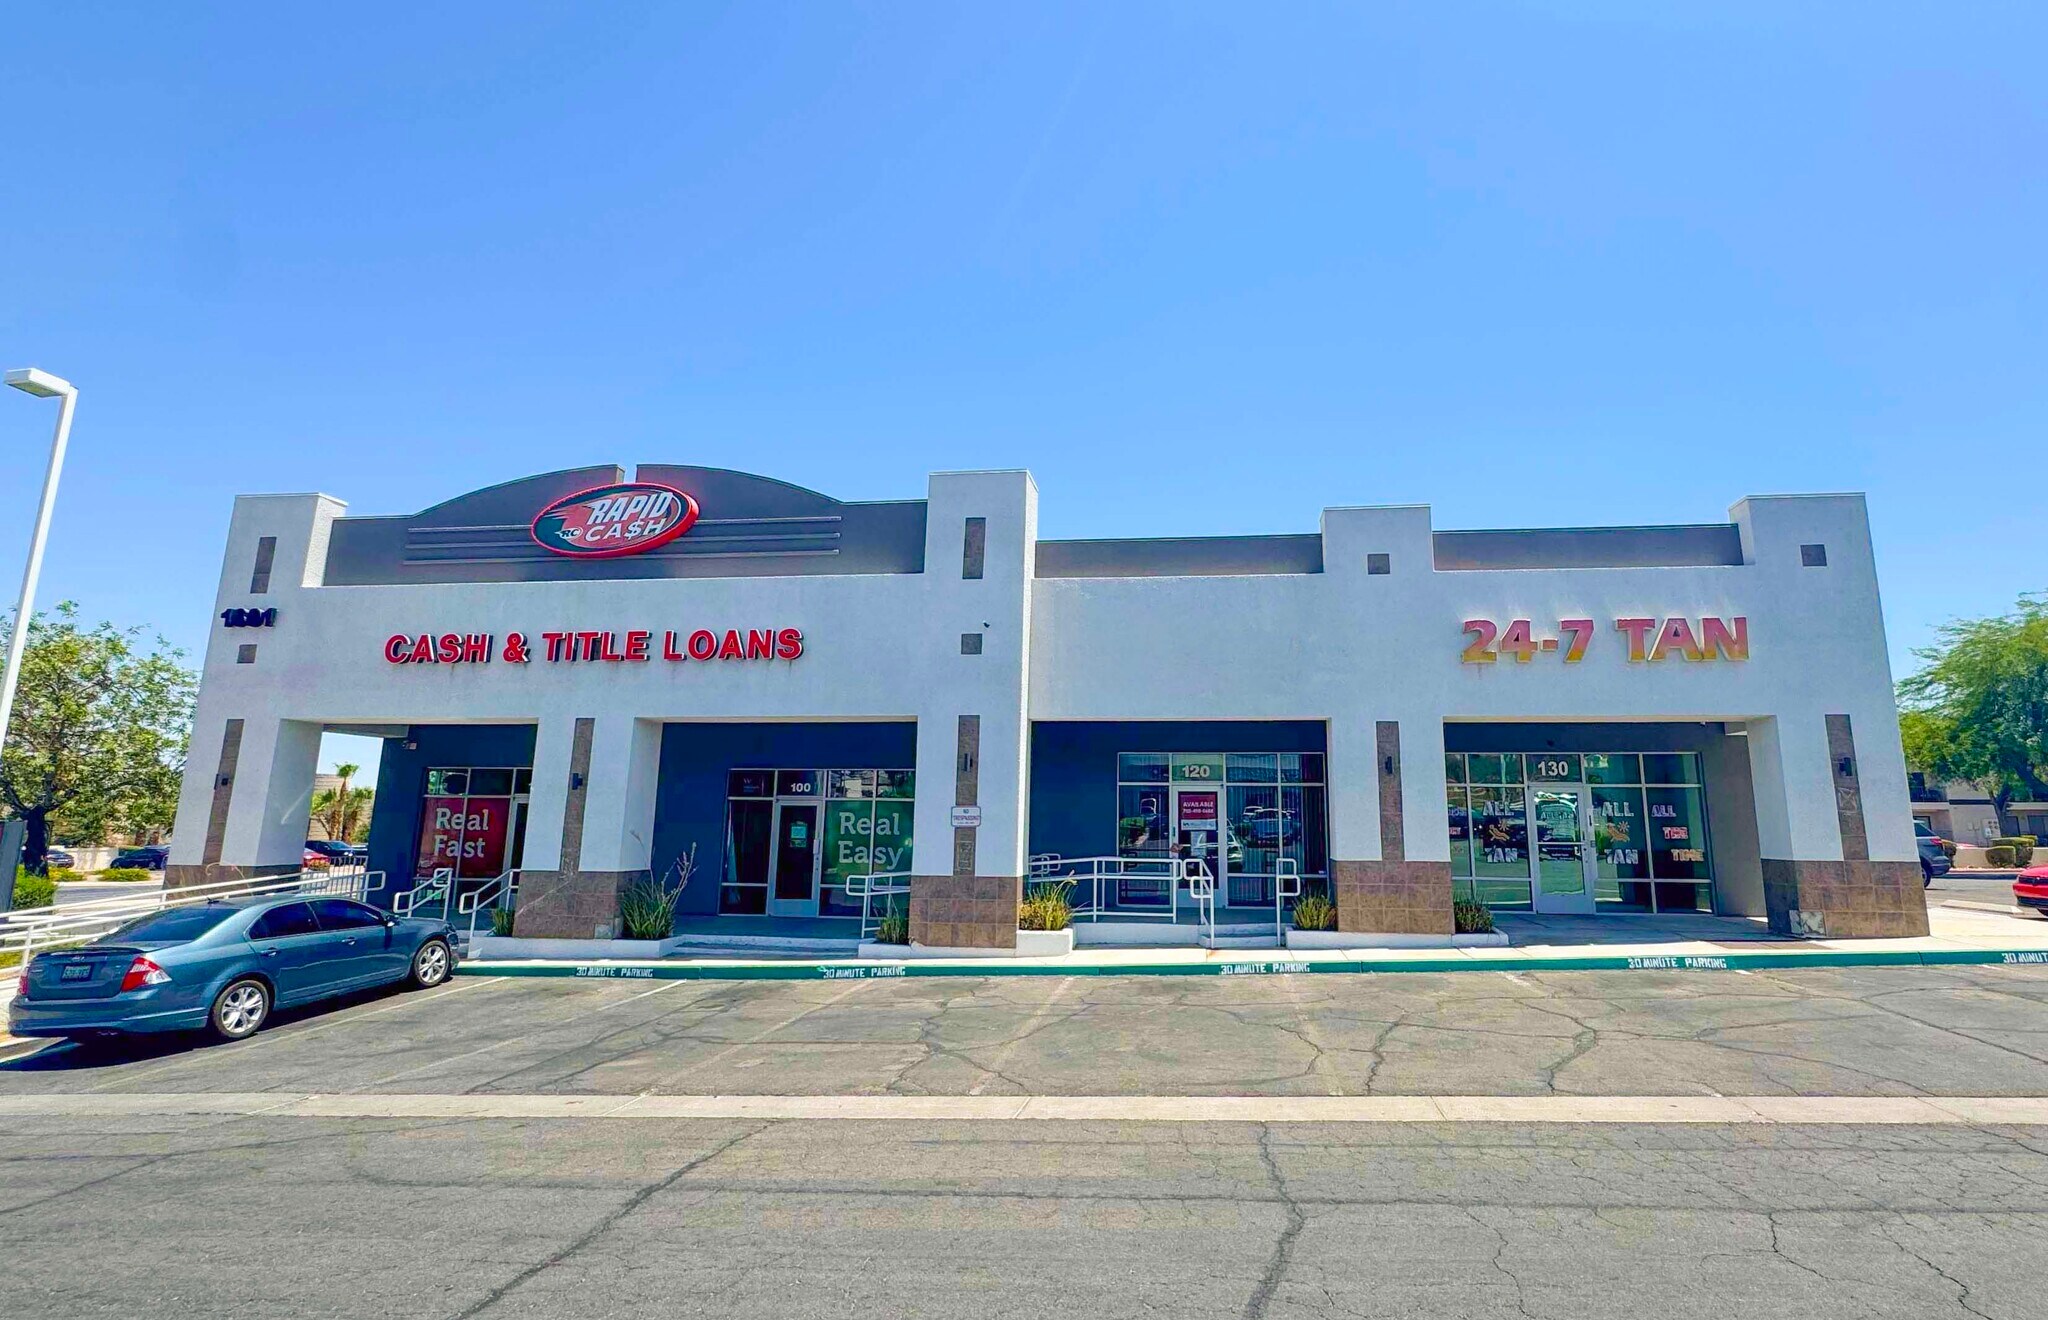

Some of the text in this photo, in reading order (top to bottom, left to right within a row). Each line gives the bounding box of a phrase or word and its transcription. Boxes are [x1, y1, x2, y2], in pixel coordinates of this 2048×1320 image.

[585, 492, 673, 525] RAPID
[585, 518, 667, 542] CA$H
[220, 607, 277, 627] 11
[384, 628, 803, 663] CASH & TITLE LOANS
[1461, 616, 1750, 664] 24-7 TAN
[1182, 765, 1210, 778] 120
[1537, 761, 1569, 777] 130
[790, 783, 811, 793] 100
[1601, 801, 1635, 817] ALL
[435, 807, 489, 831] Real
[838, 812, 900, 836] Real
[433, 834, 486, 858] Fast
[838, 840, 904, 870] Easy
[1603, 848, 1639, 865] TAN
[1627, 957, 1727, 969] 30 MINUTE PARKING
[2002, 952, 2017, 963] 30
[576, 966, 654, 978] 30 MINUTE PARKING
[823, 966, 906, 978] 30 MINUTE PARKING
[1221, 963, 1310, 975] 30 MINUTE PARKING
